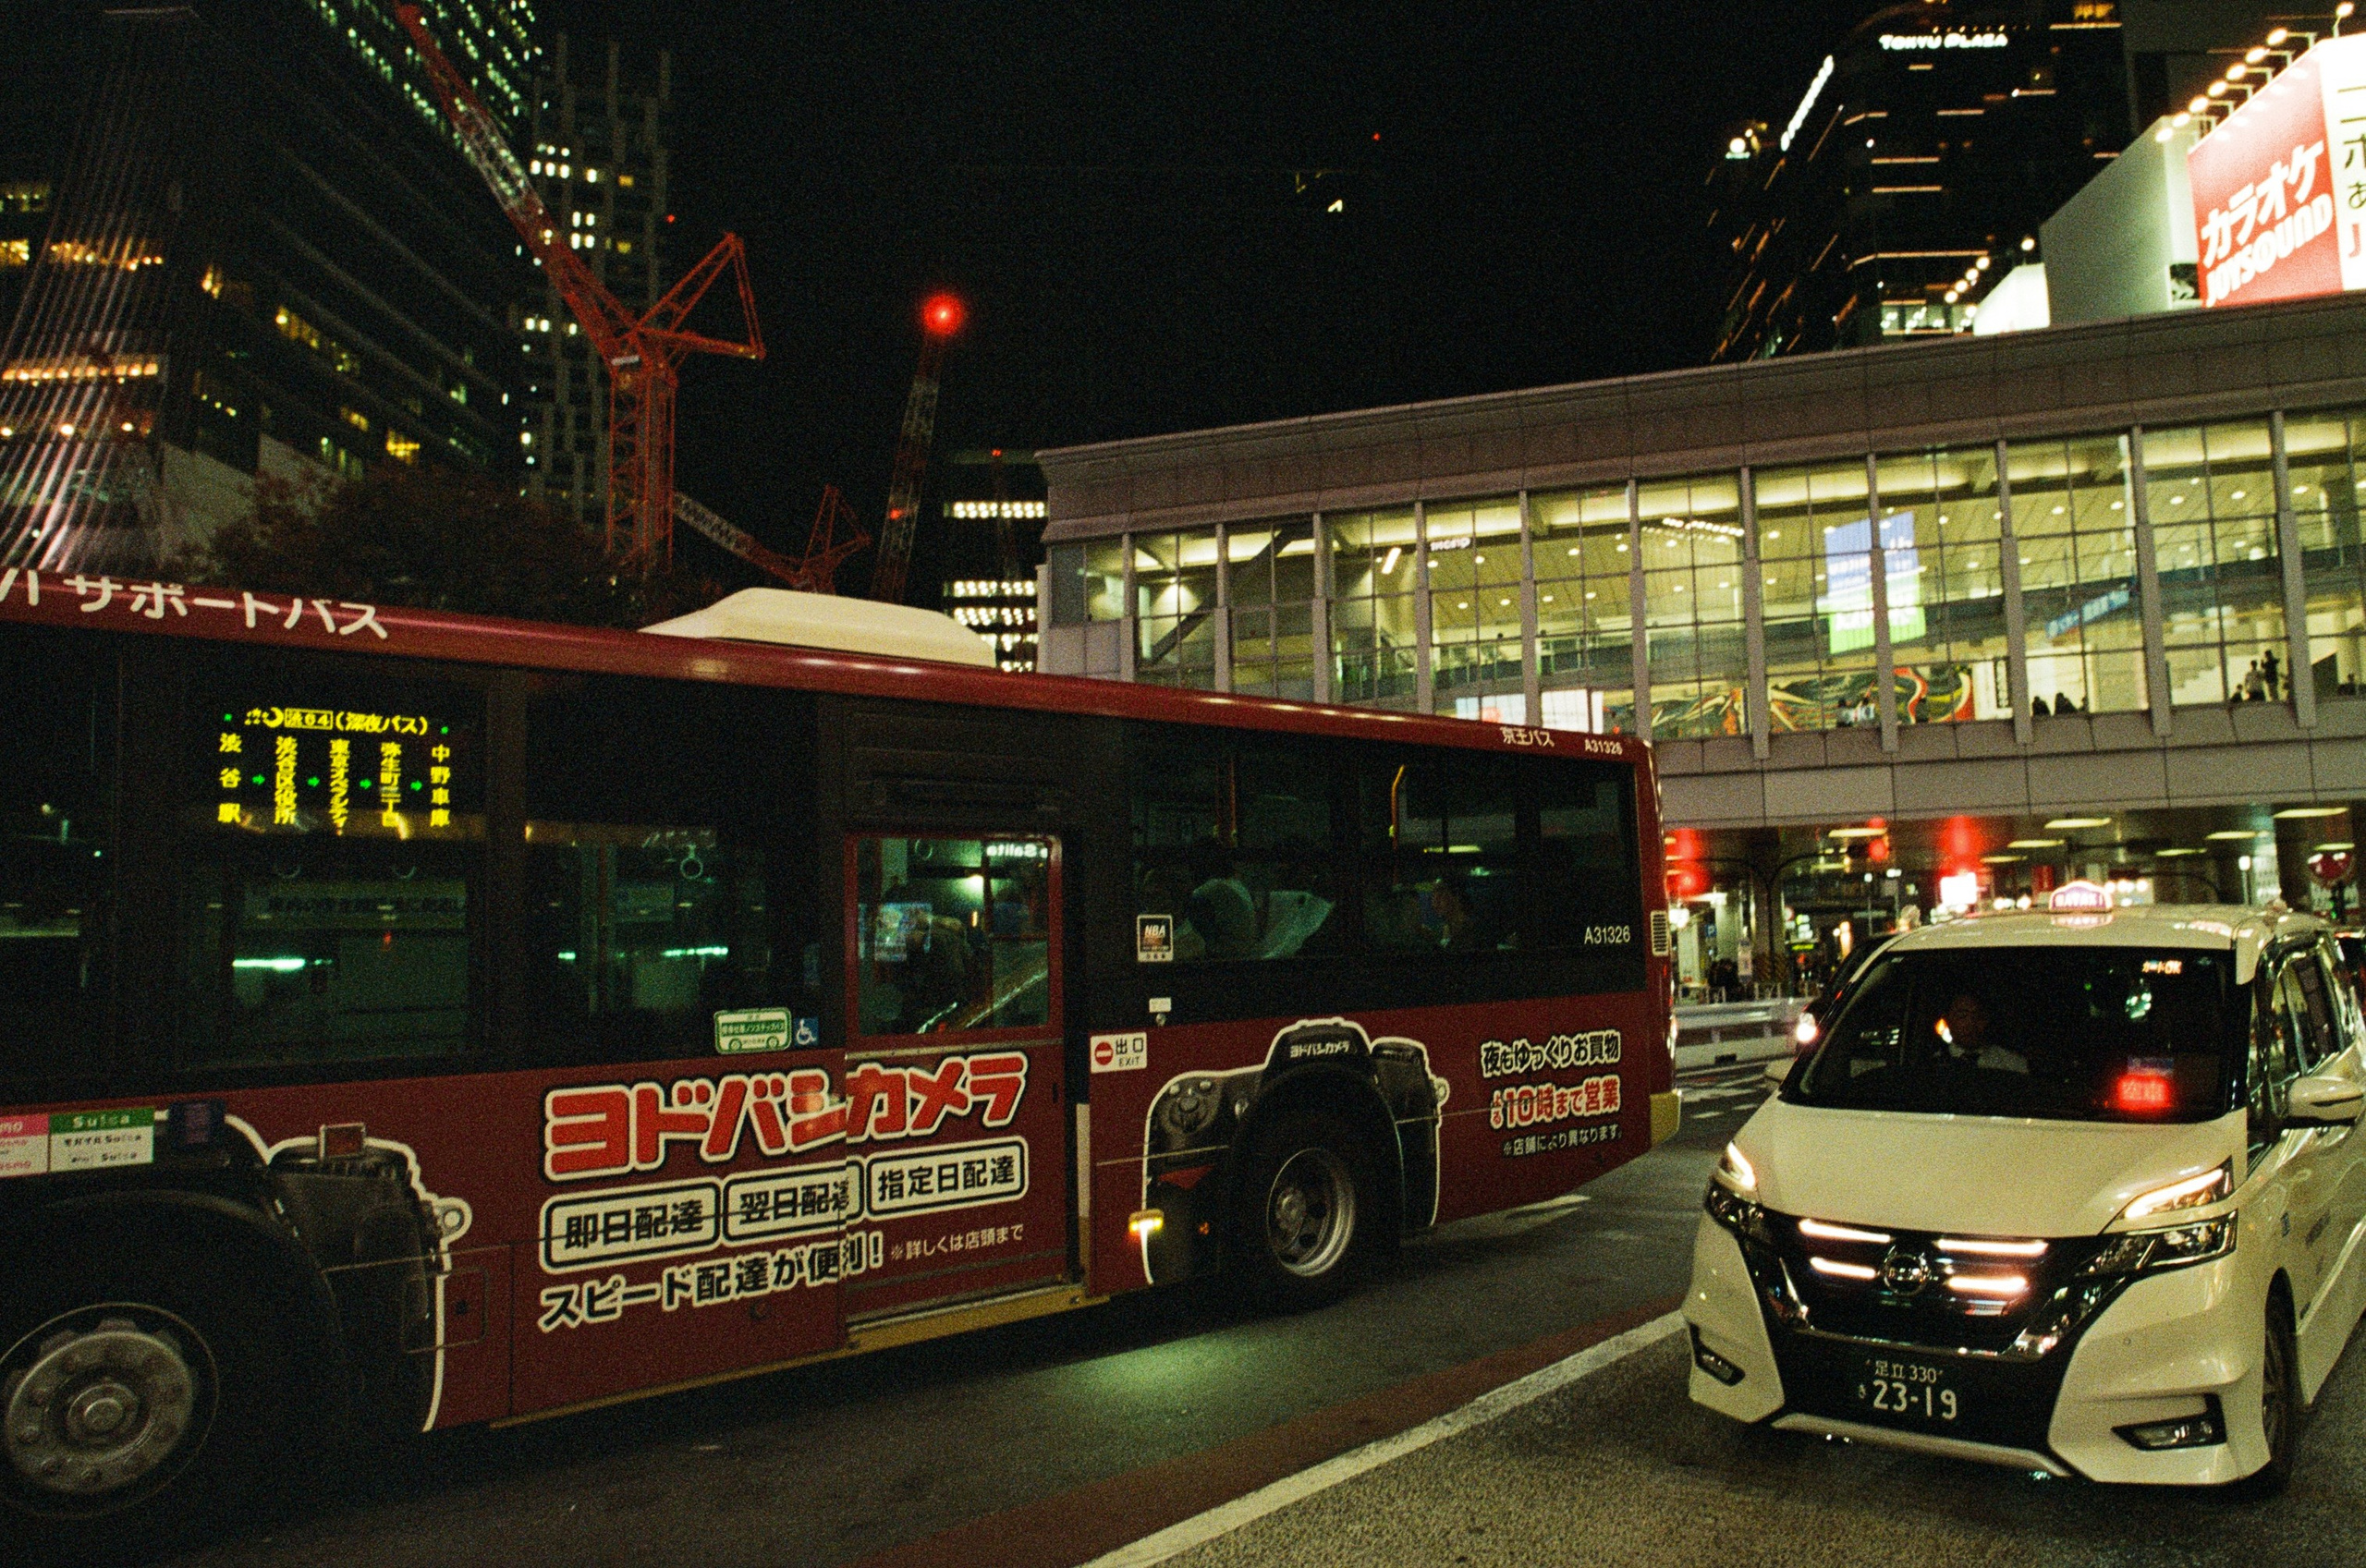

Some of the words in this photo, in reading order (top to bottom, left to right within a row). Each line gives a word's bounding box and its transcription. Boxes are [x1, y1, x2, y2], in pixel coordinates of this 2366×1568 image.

[1879, 34, 1942, 50] TOKYU
[1945, 33, 2007, 48] PLAZA
[2201, 140, 2325, 269] カラオケ
[2206, 193, 2334, 308] JOYSOUND
[63, 574, 388, 639] サポートバス
[1500, 727, 1555, 748] 京王バス
[1584, 738, 1623, 755] A31326
[217, 733, 242, 822] 渋谷駅
[274, 735, 298, 824] 渋谷区役所
[431, 744, 450, 826] 中野車庫
[1144, 925, 1166, 938] NBA
[1584, 925, 1630, 944] A31326
[1116, 1038, 1144, 1056] 出口
[1119, 1056, 1140, 1068] EXIT
[1290, 1041, 1350, 1058] ヨドバシカメラ
[1481, 1029, 1621, 1078] 夜もゆっくりお買物
[72, 1114, 129, 1128] Suica
[543, 1051, 1030, 1181] ヨドバシカメラ
[877, 1153, 1016, 1200] 指定日配達
[565, 1199, 703, 1249] 即日配達
[1874, 1360, 1905, 1380] 足立
[1909, 1365, 1937, 1383] 330
[1872, 1380, 1957, 1421] 23-19
